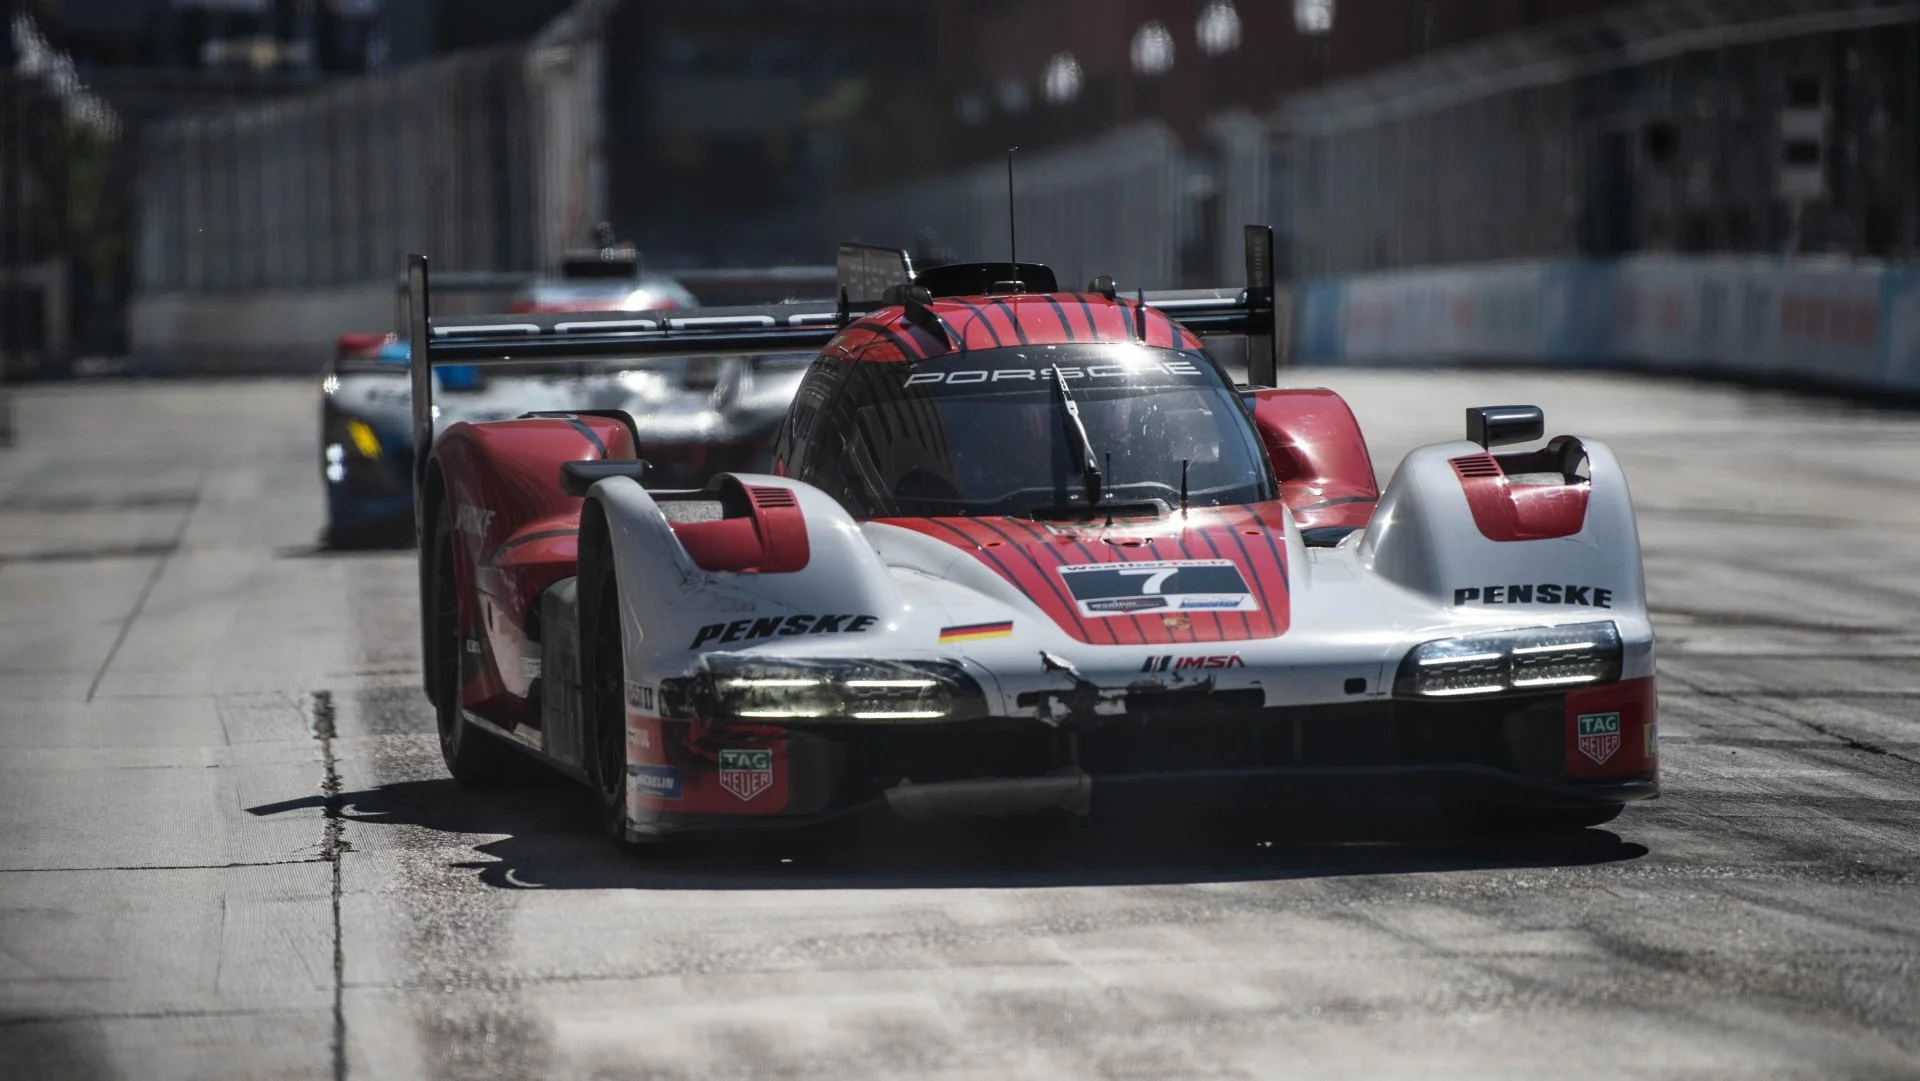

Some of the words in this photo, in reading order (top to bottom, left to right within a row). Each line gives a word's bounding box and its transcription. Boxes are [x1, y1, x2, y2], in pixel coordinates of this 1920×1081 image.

[1118, 568, 1179, 595] 7
[1454, 583, 1613, 609] PENSKE
[689, 614, 880, 651] PENSKE
[1175, 655, 1246, 670] IMSA
[1582, 716, 1617, 734] TAG
[1582, 734, 1618, 759] HEUER
[723, 753, 768, 769] TAG
[723, 772, 769, 797] HEUER
